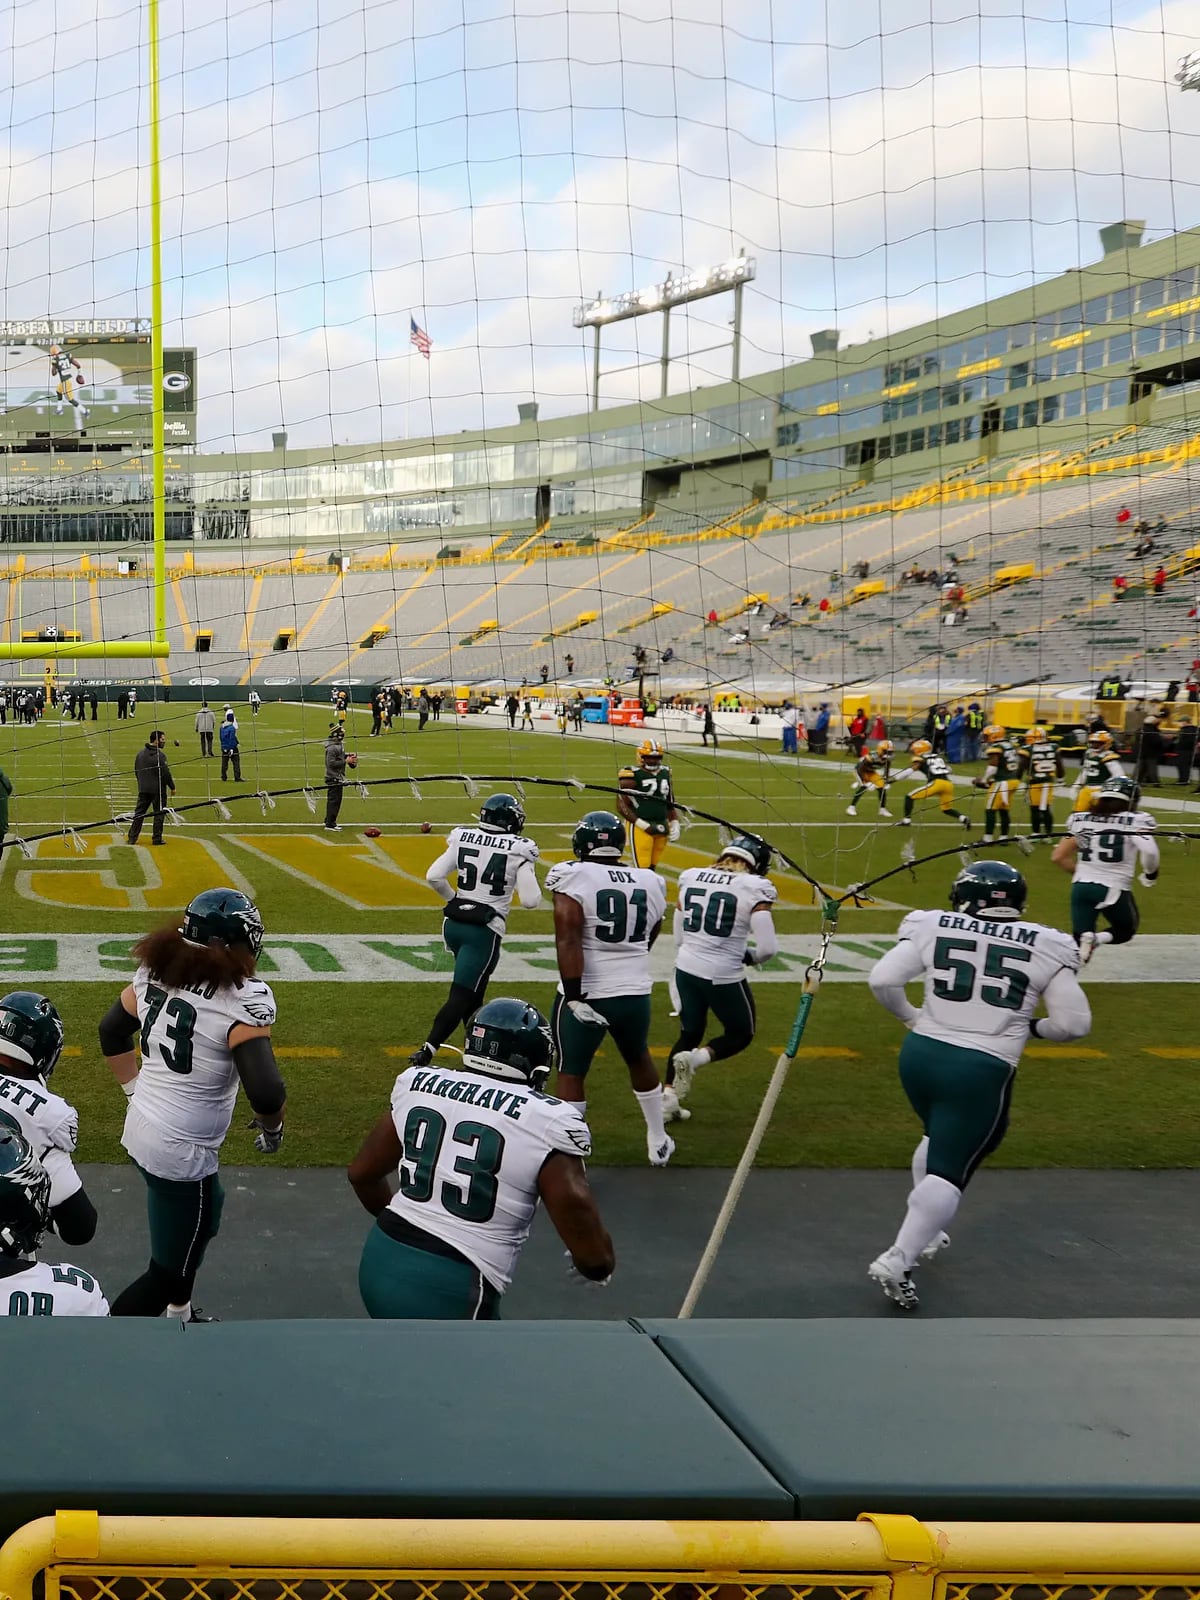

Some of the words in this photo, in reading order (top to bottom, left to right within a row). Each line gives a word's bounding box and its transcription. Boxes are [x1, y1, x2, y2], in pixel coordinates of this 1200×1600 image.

[74, 319, 127, 334] FIELD
[459, 831, 518, 852] BRADLEY
[1075, 828, 1124, 863] 49
[457, 847, 509, 897] 54
[608, 869, 637, 884] COX
[695, 871, 738, 887] RILEY
[595, 888, 648, 944] 91
[683, 887, 739, 938] 50
[938, 914, 1040, 947] GRAHAM
[932, 936, 1032, 1011] 55
[139, 982, 198, 1075] 73
[409, 1071, 529, 1121] HARGRAVE
[400, 1106, 506, 1223] 93
